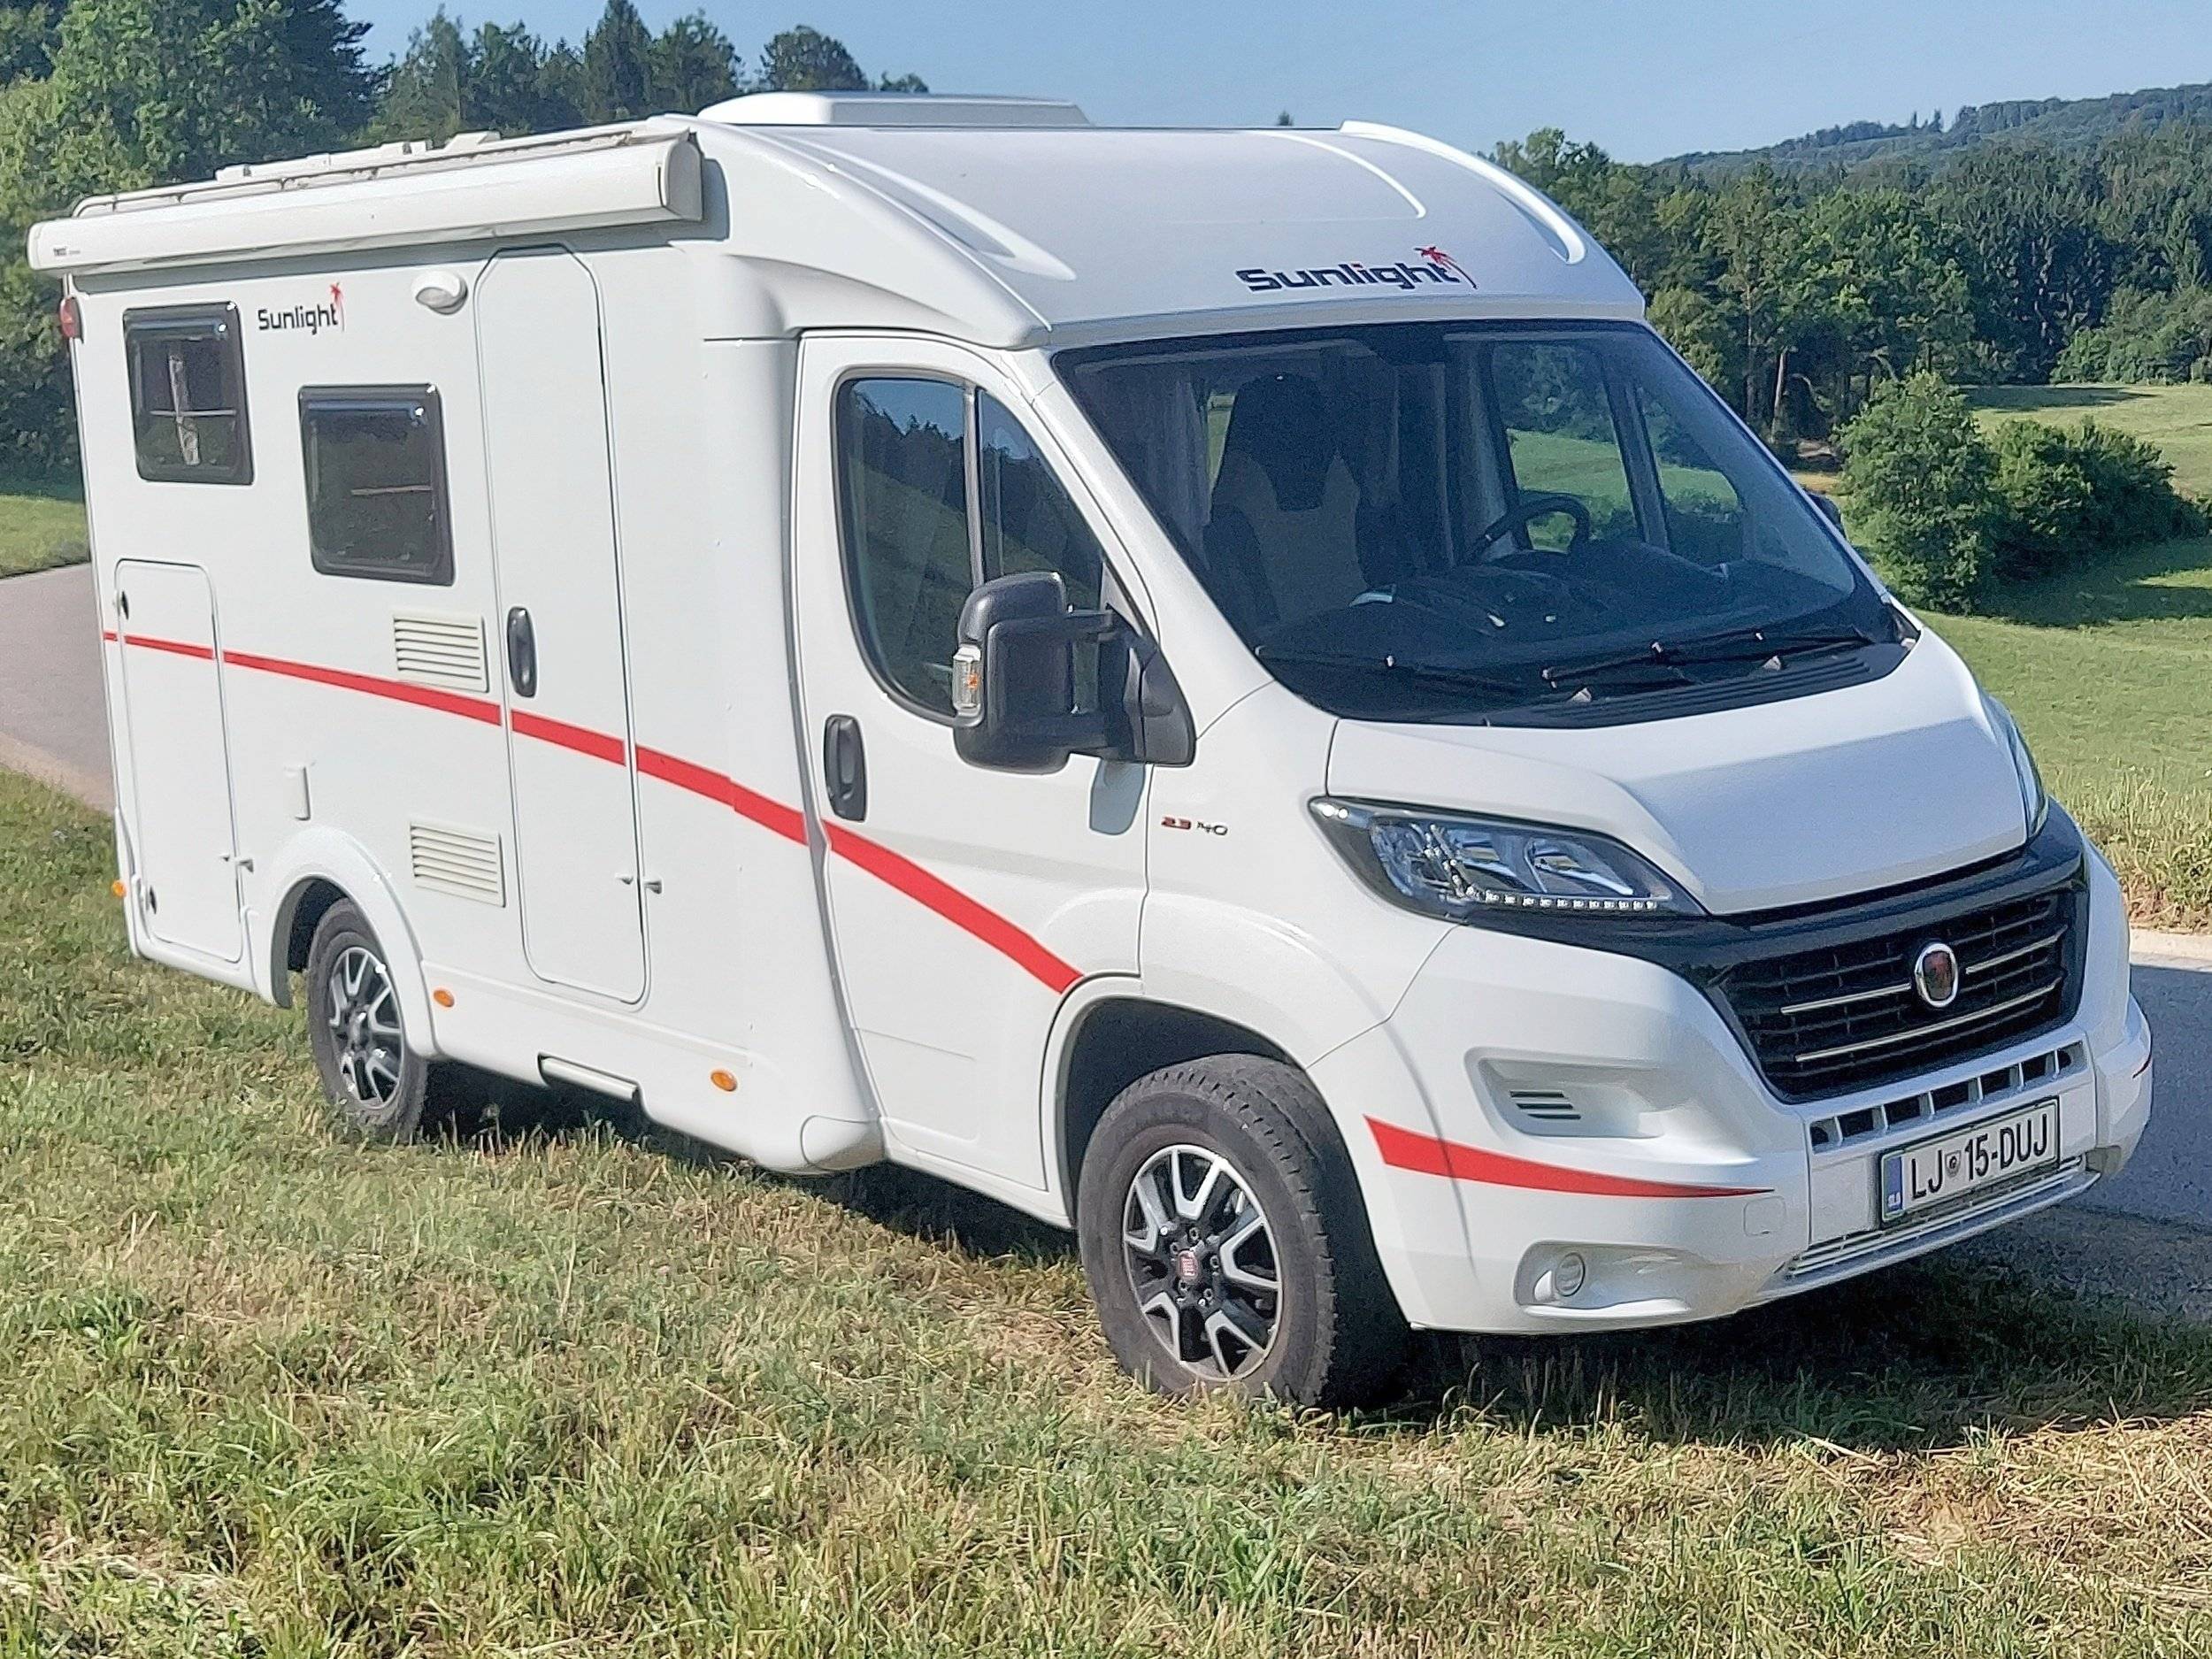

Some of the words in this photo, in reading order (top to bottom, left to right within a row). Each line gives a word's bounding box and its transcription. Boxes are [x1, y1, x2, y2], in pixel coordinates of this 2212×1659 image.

[1235, 262, 1462, 292] Sunlight
[257, 303, 338, 335] Sunlight
[1911, 1149, 1944, 1200] LJ
[1964, 1113, 2048, 1182] 15-DUJ
